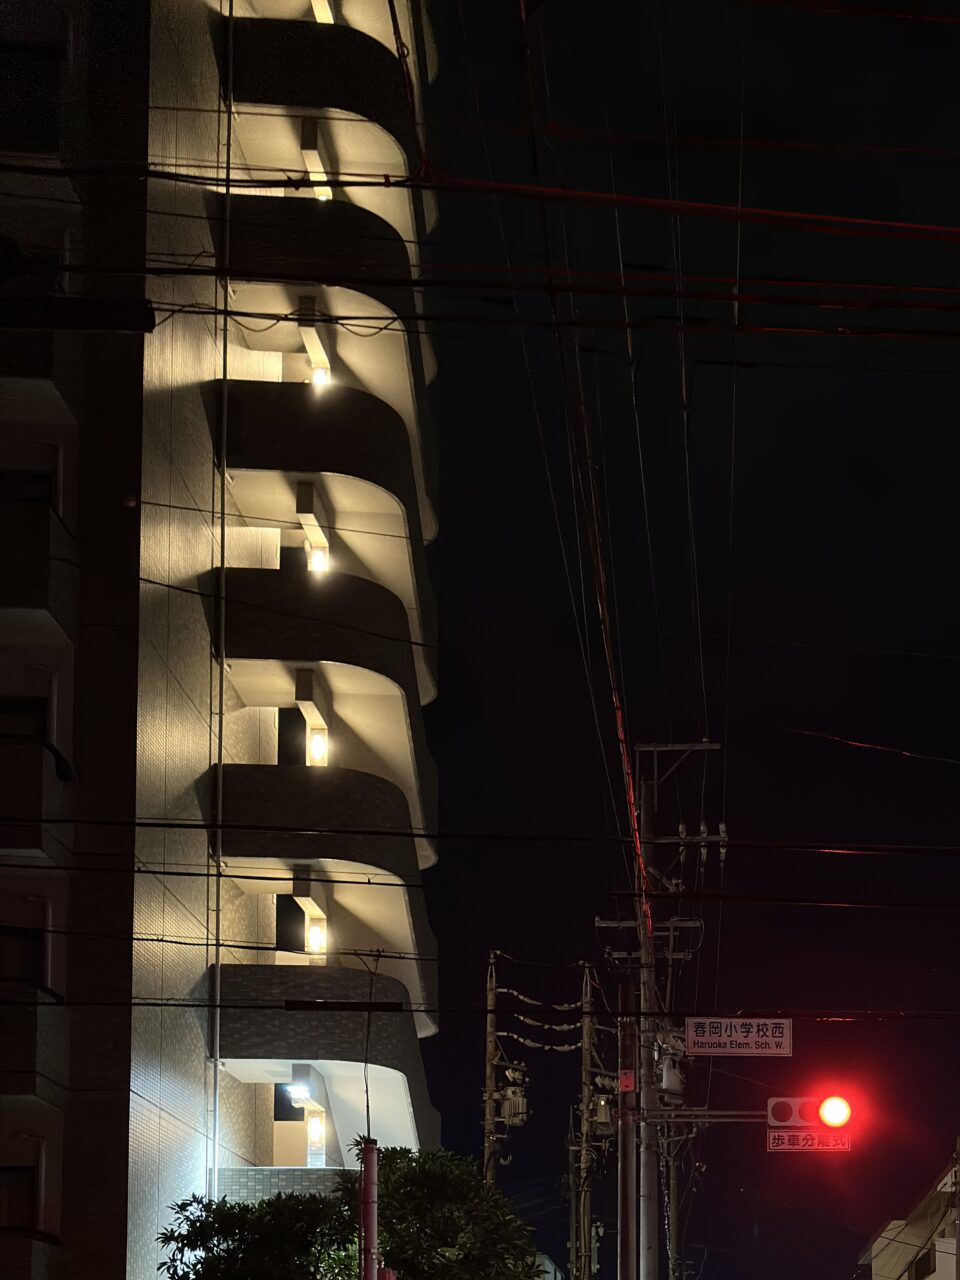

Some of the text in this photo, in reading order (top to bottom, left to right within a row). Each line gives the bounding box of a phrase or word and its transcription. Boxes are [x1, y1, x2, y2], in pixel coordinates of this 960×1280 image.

[693, 1022, 785, 1038] 春岡小学校西
[693, 1040, 785, 1050] Haruoka Elem. Sch. W.
